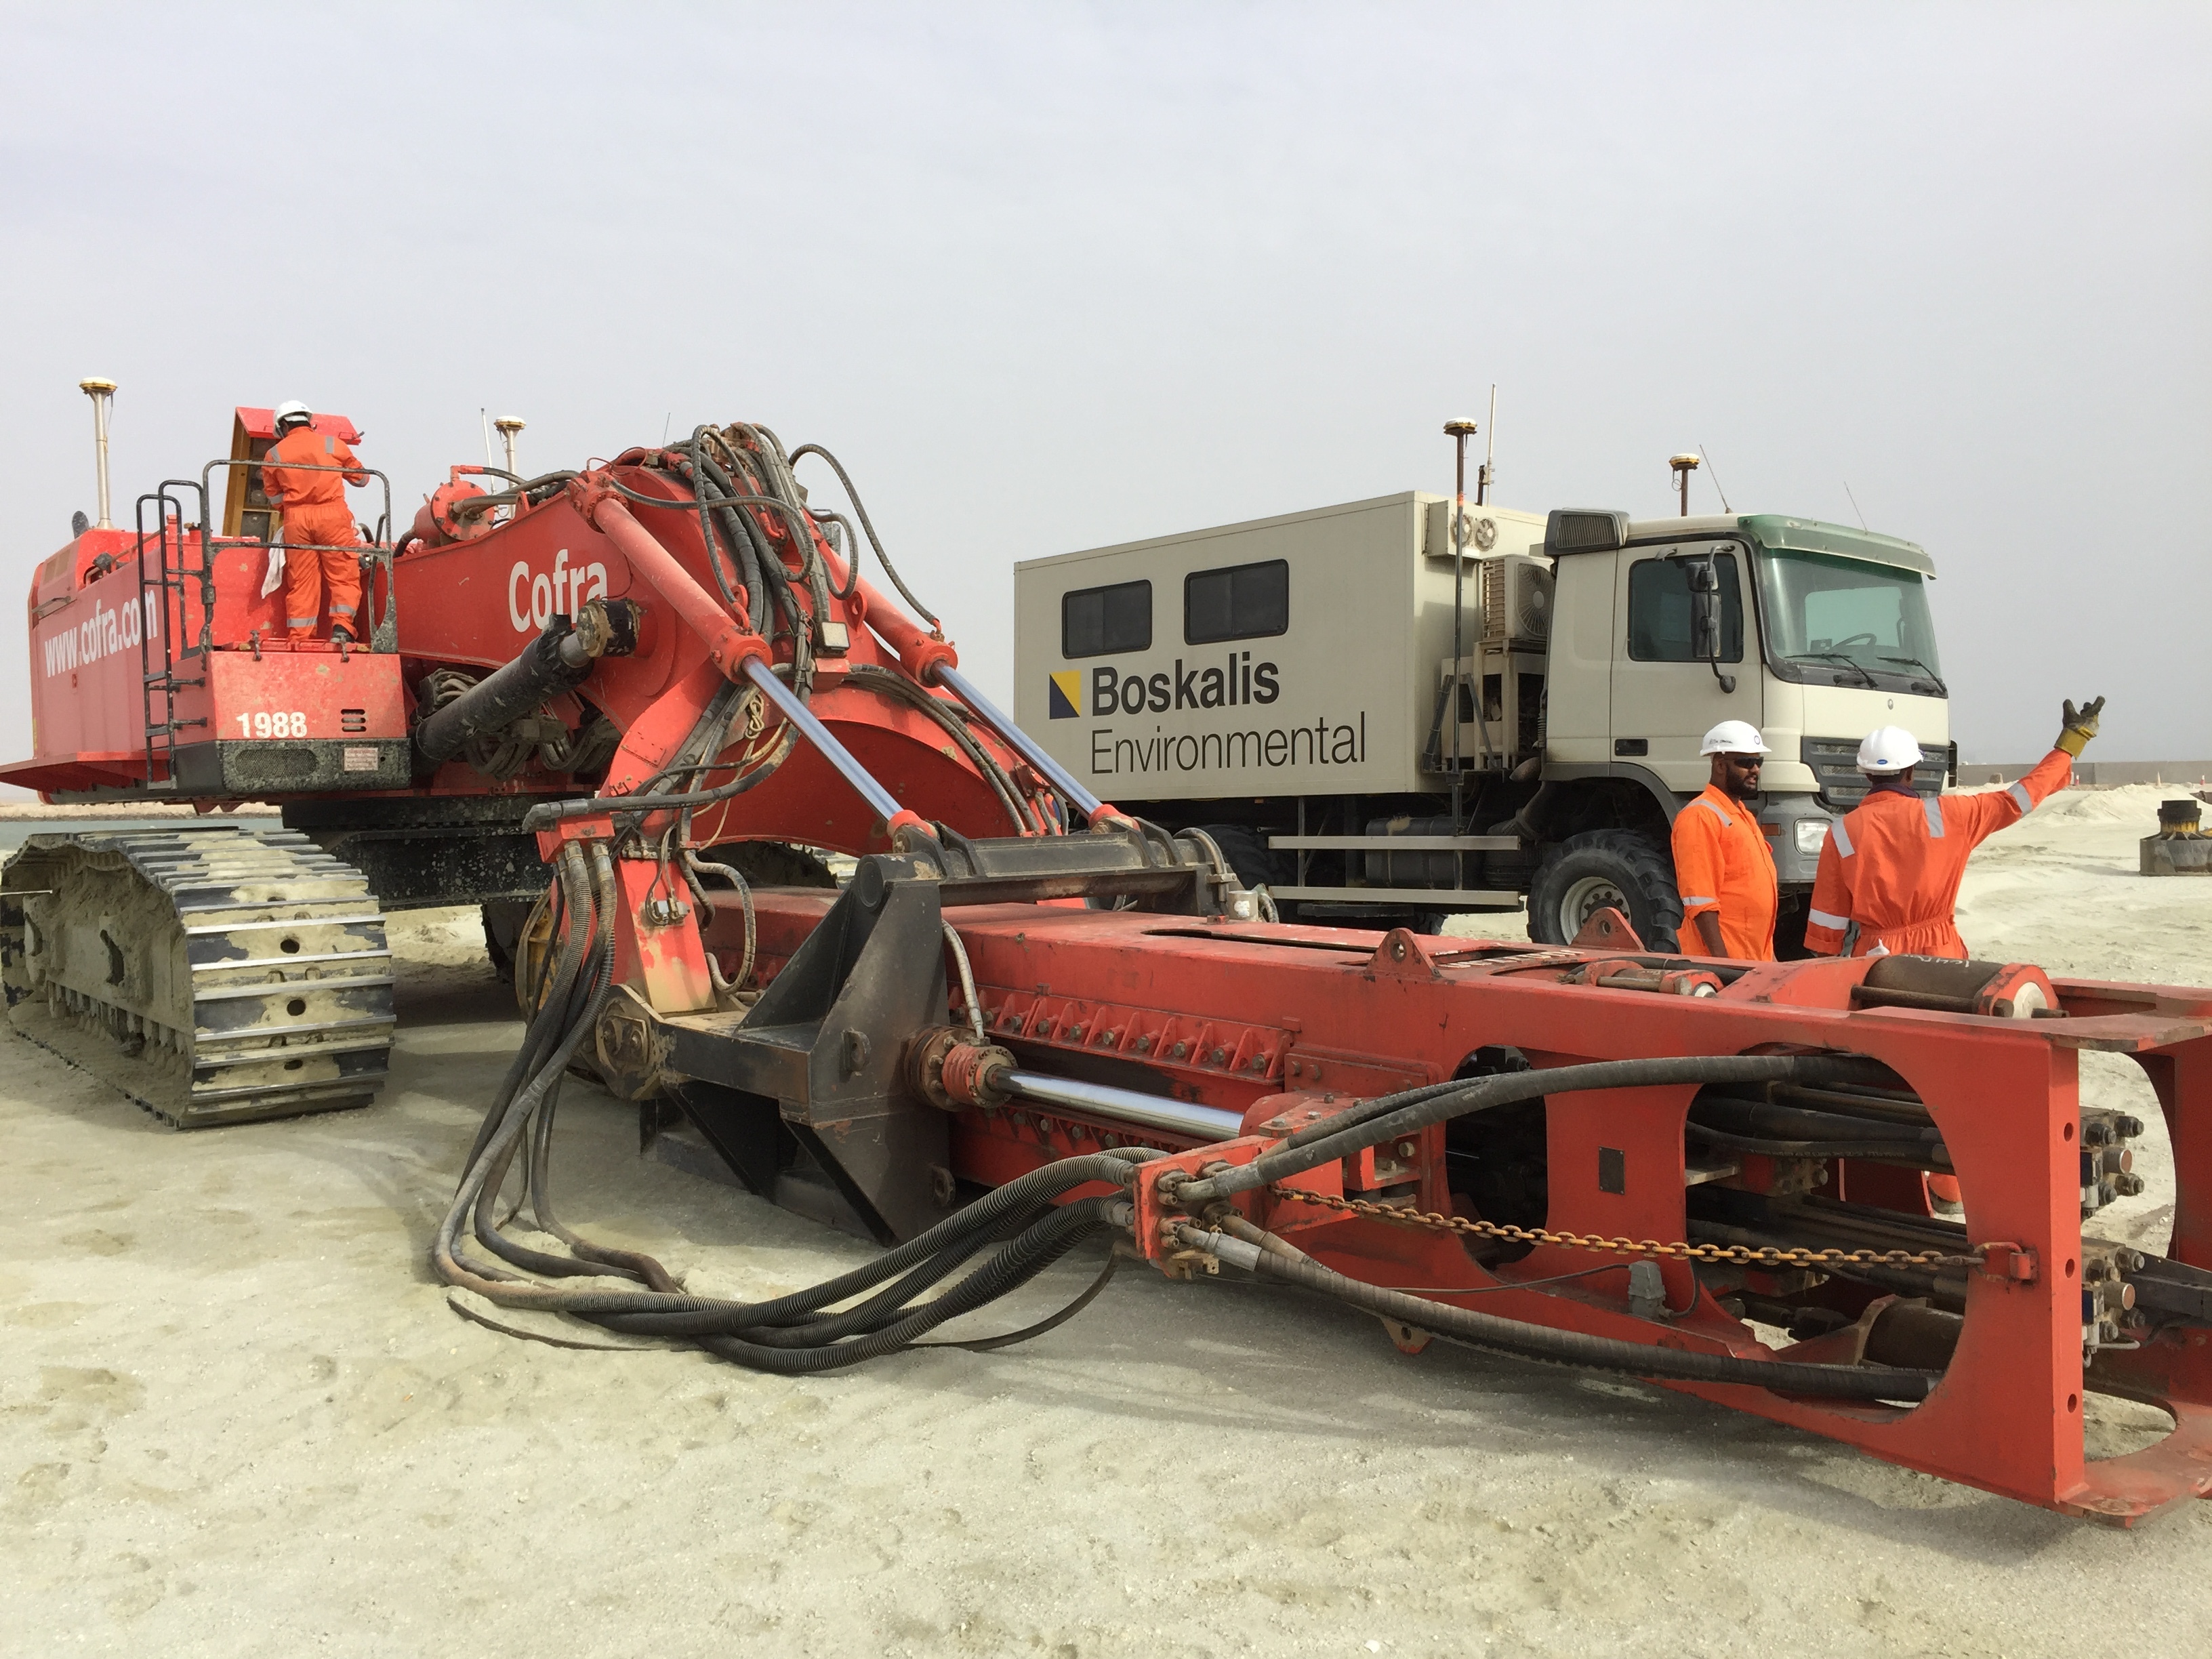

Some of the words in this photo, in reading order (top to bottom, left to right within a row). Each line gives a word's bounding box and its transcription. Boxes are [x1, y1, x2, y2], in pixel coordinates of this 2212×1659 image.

[509, 548, 609, 633] Cofra
[1092, 651, 1280, 716] Boskalis
[236, 712, 308, 738] 1988
[1092, 711, 1365, 774] Environmental
